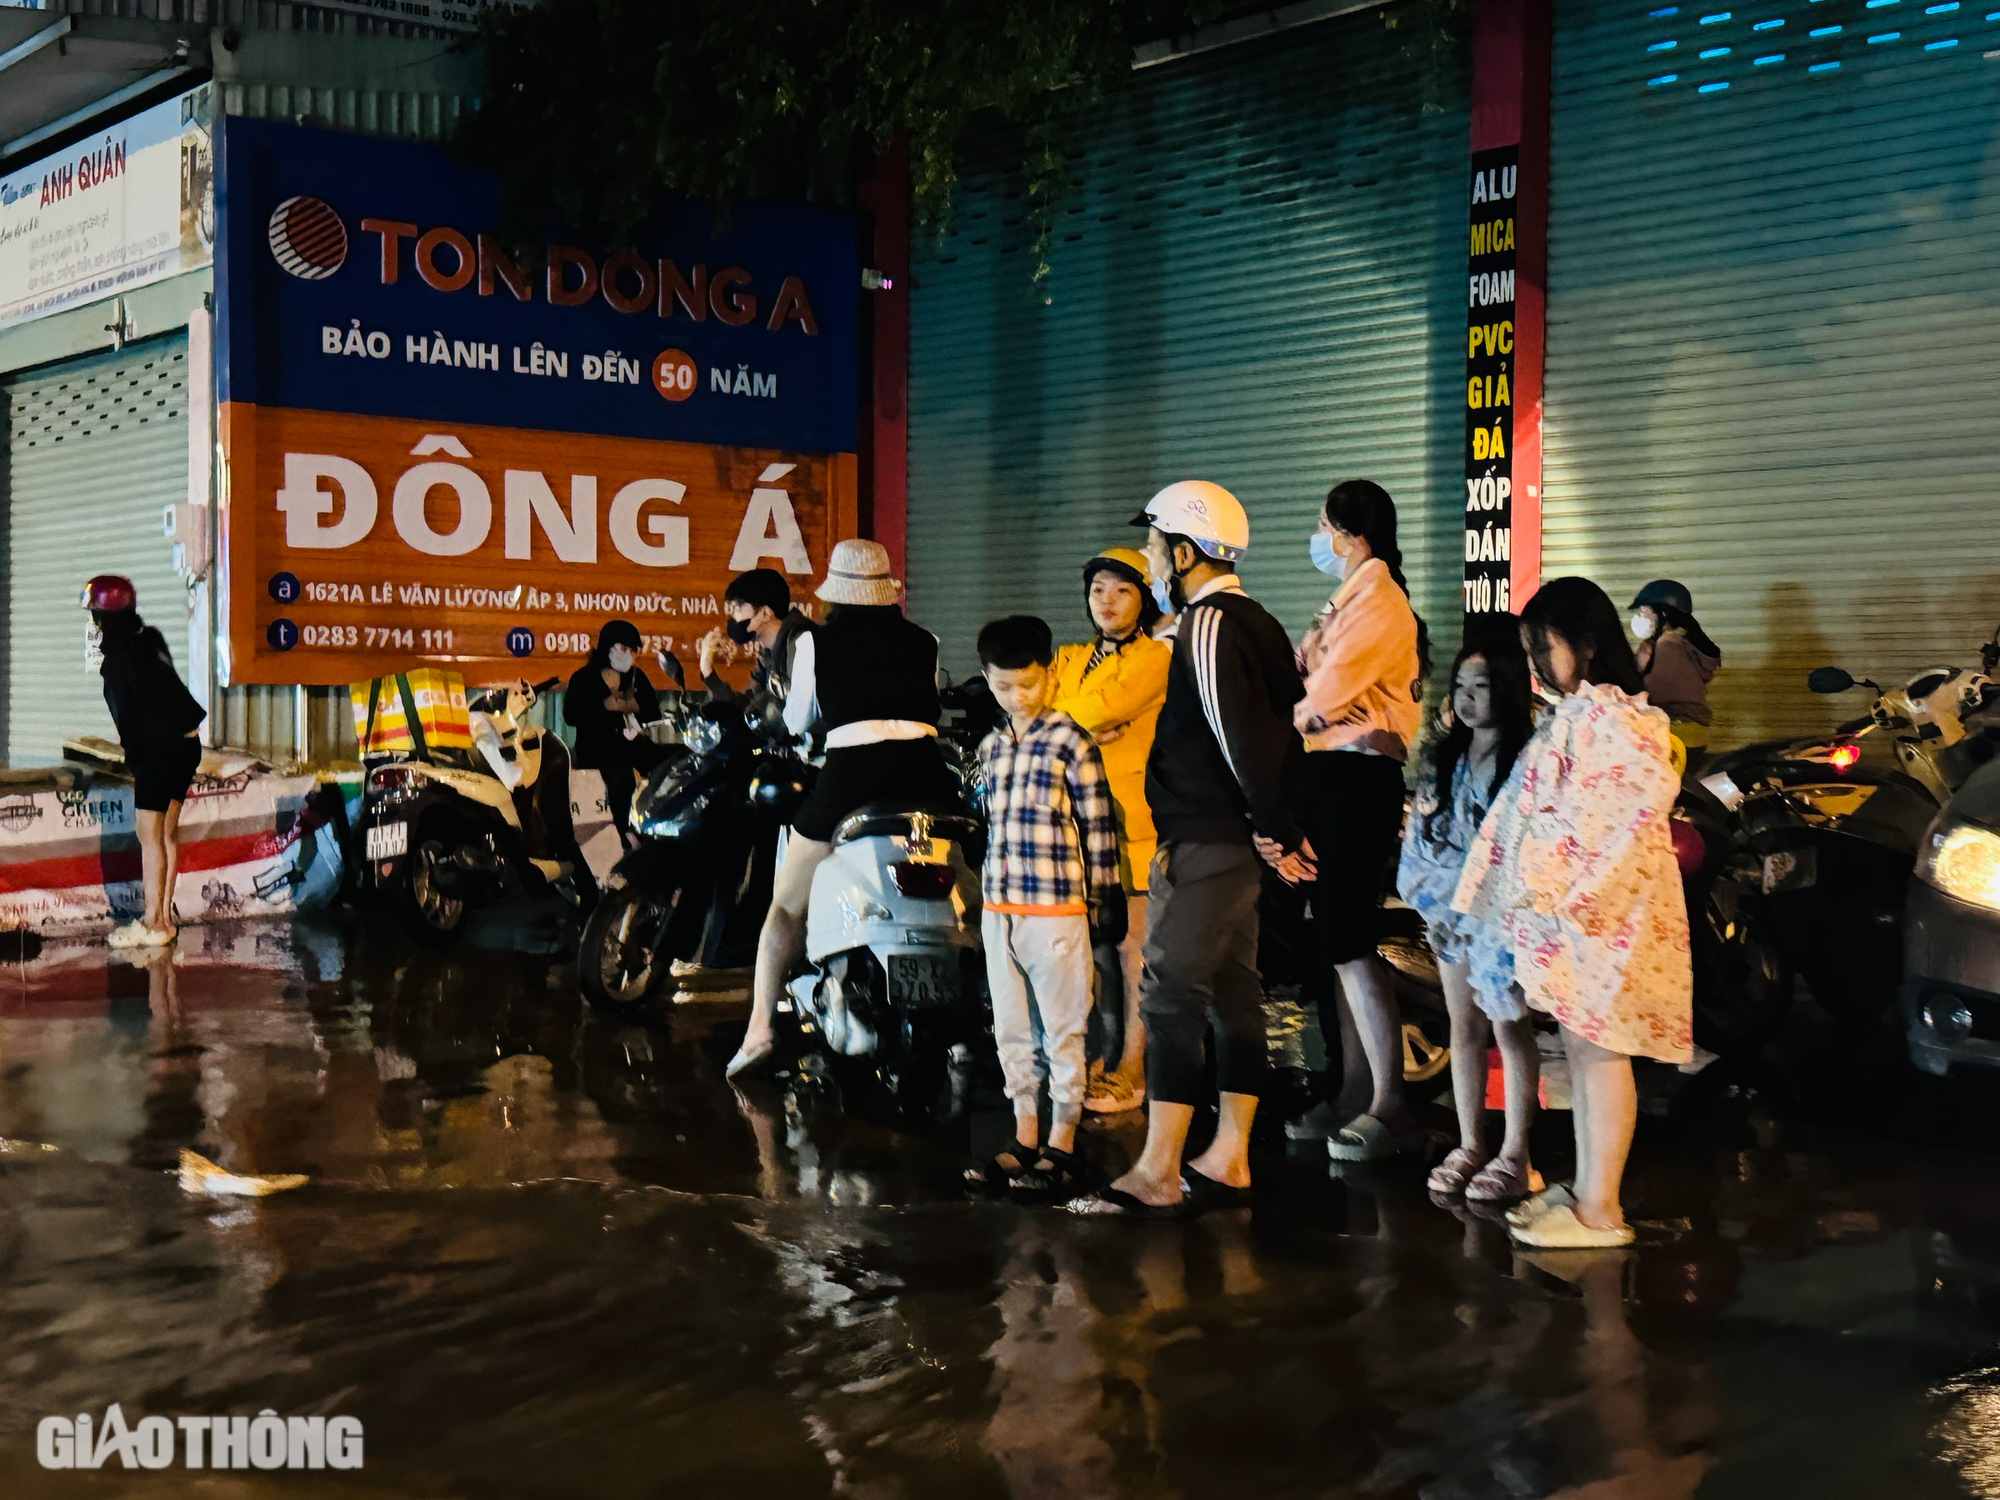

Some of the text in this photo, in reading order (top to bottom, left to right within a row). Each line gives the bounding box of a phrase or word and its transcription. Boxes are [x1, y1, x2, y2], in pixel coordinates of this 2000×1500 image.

[40, 162, 73, 210] ANH
[78, 135, 126, 191] QUÂN
[1472, 165, 1517, 204] ALU
[1470, 218, 1516, 257] MICA
[766, 274, 820, 337] A
[1469, 269, 1515, 308] FOAM
[322, 318, 777, 398] BẢO HÀNH LÊN ĐẾN 50 NĂM
[1468, 320, 1514, 358] PVC
[1467, 361, 1511, 410] GIẢ
[1472, 417, 1506, 460] ĐÁ
[276, 434, 814, 575] ĐÔNG Á
[1466, 465, 1511, 511] XỐP
[1465, 521, 1510, 562] DÁN
[305, 581, 365, 604] 1621A
[371, 581, 393, 604] LÊ
[399, 581, 440, 606] VĂN
[574, 592, 630, 612] NHƠN
[634, 592, 677, 616] ĐỨC,
[682, 594, 719, 615] NHÀ
[303, 625, 358, 647] 0283
[364, 626, 414, 649] 7714
[421, 629, 453, 650] 111
[544, 632, 591, 652] 0918
